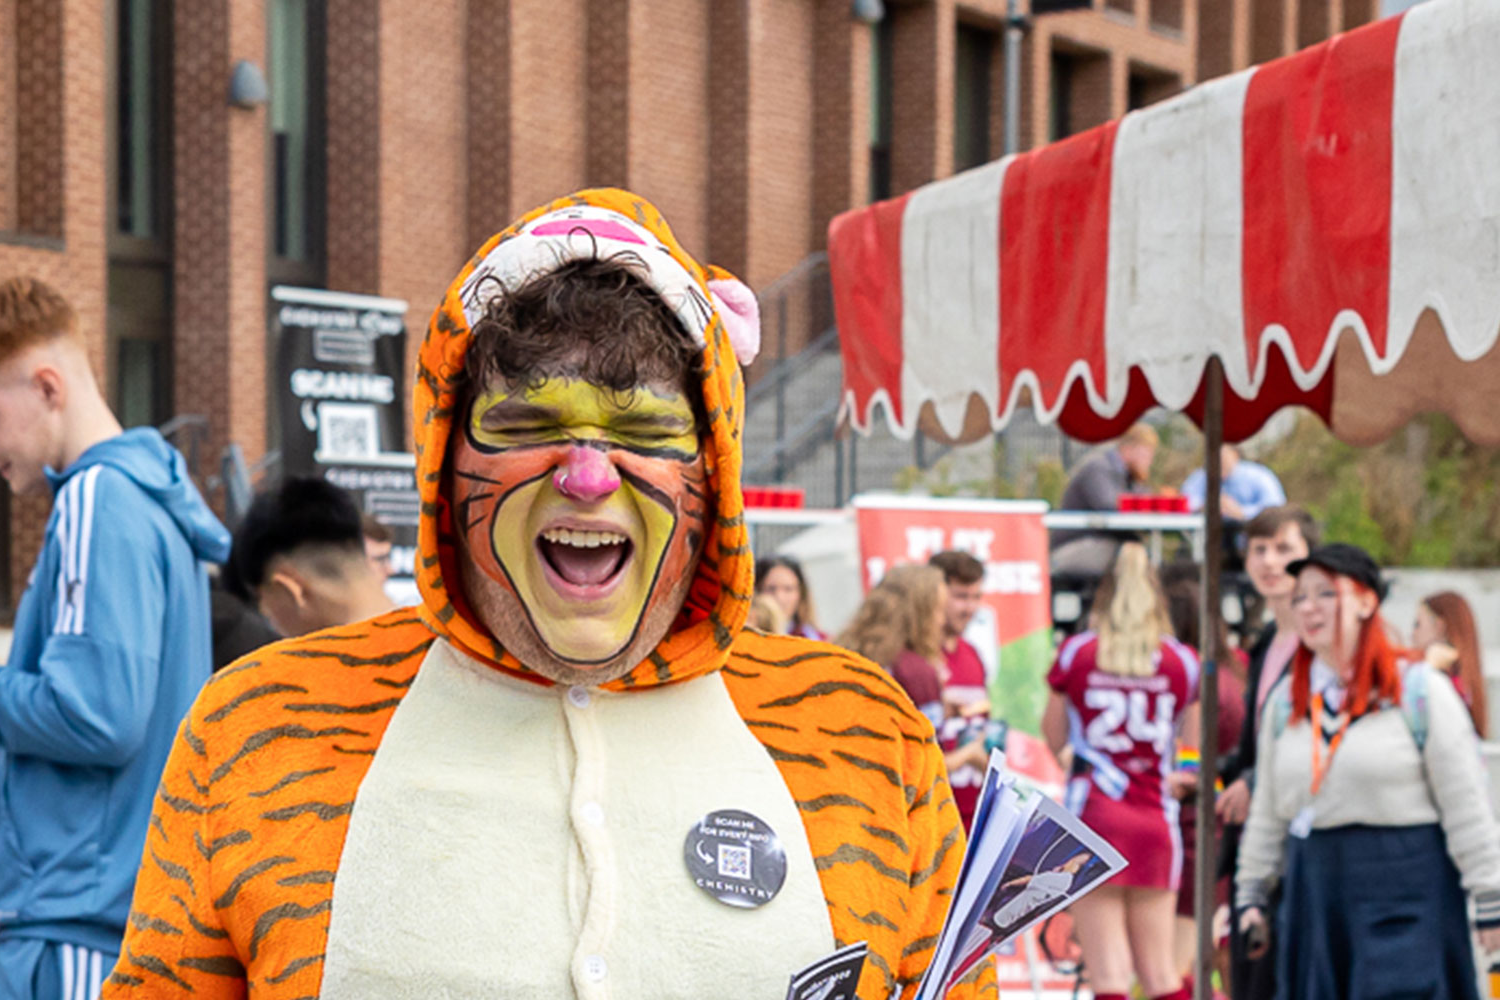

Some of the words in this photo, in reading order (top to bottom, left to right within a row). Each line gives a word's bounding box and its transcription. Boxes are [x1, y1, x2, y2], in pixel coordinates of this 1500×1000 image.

[1083, 688, 1176, 756] 24
[714, 818, 741, 828] SCAN
[742, 820, 756, 830] ME
[696, 878, 774, 899] CHEMISTRY
